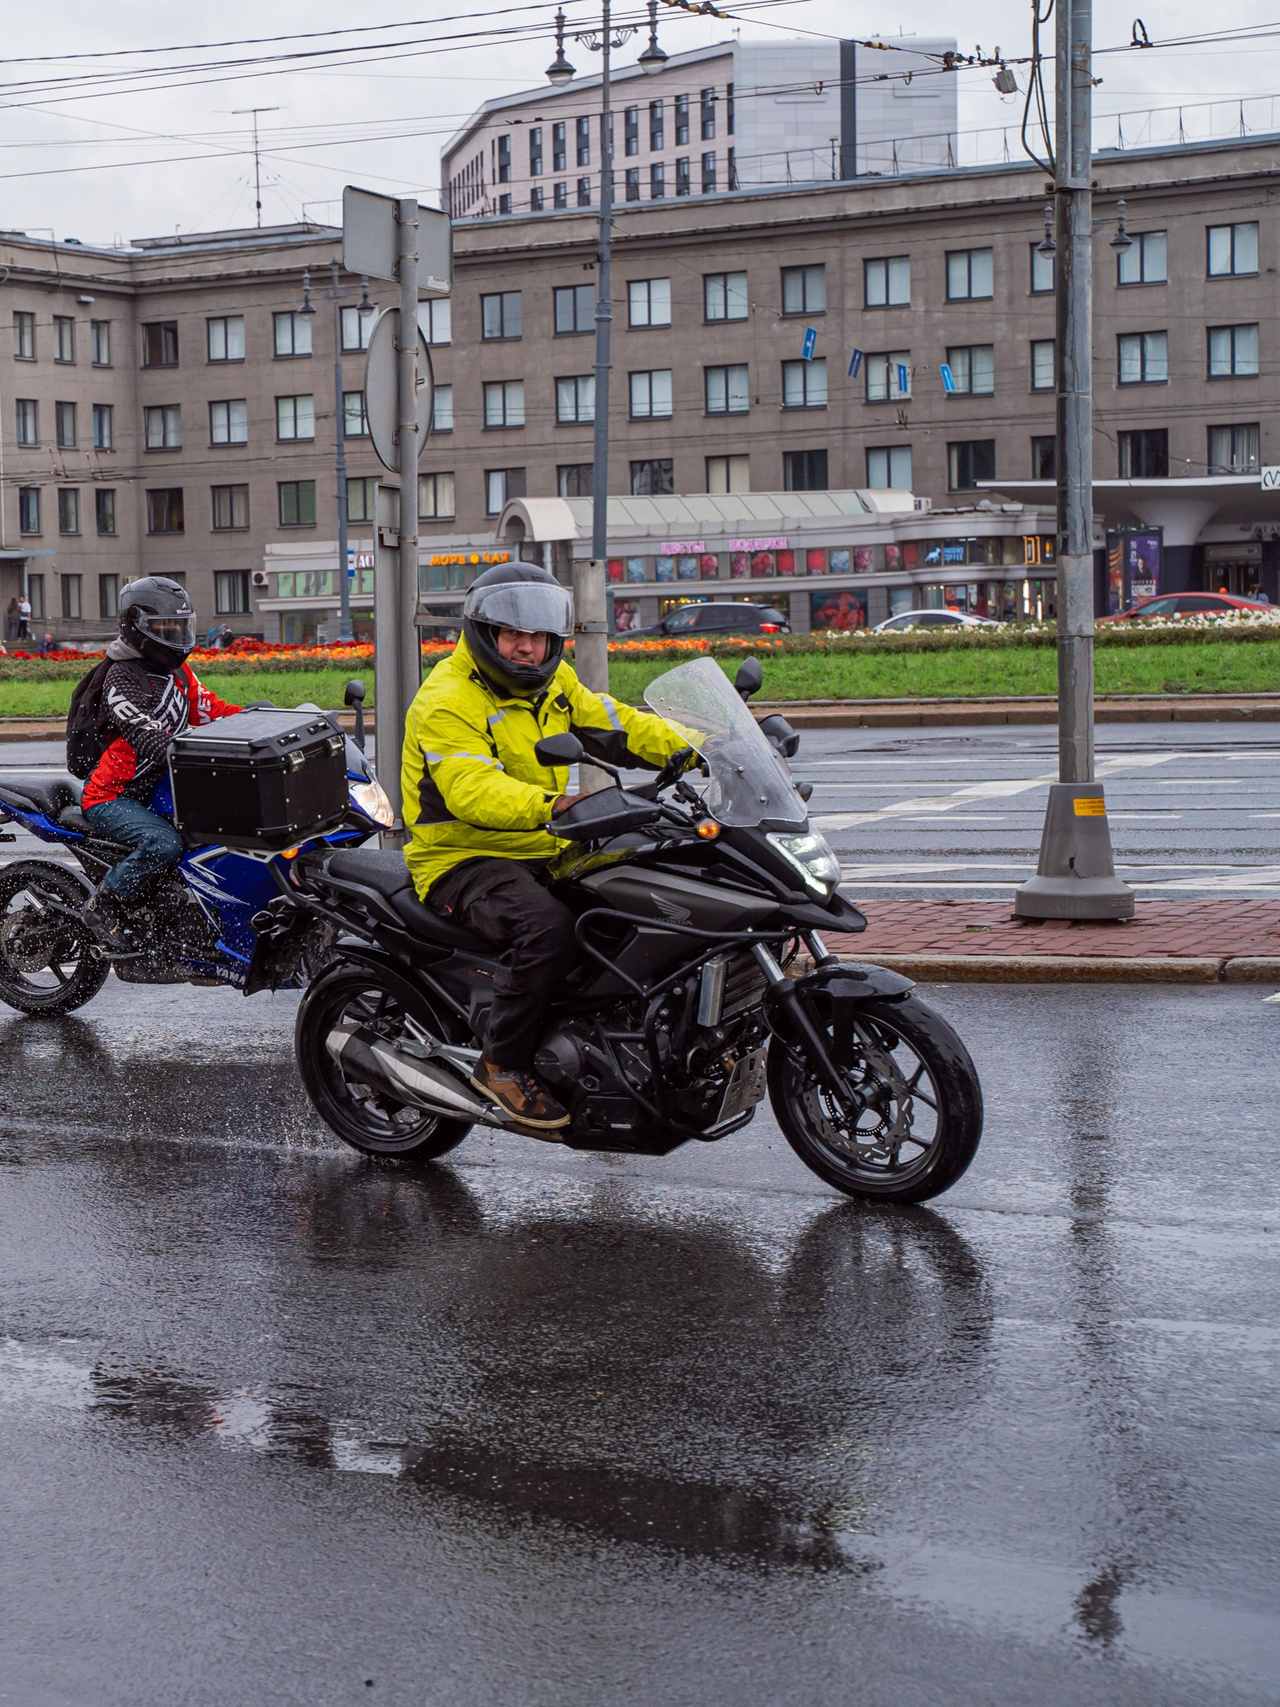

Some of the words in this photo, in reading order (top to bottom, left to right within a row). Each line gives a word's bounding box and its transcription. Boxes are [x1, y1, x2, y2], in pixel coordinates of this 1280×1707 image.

[661, 541, 705, 556] ЦВЕТЫ
[729, 537, 787, 552] ПОДАРКИ
[430, 553, 467, 566] МОРЕ
[482, 552, 509, 564] ЧАЯ
[215, 965, 246, 985] YAMA
